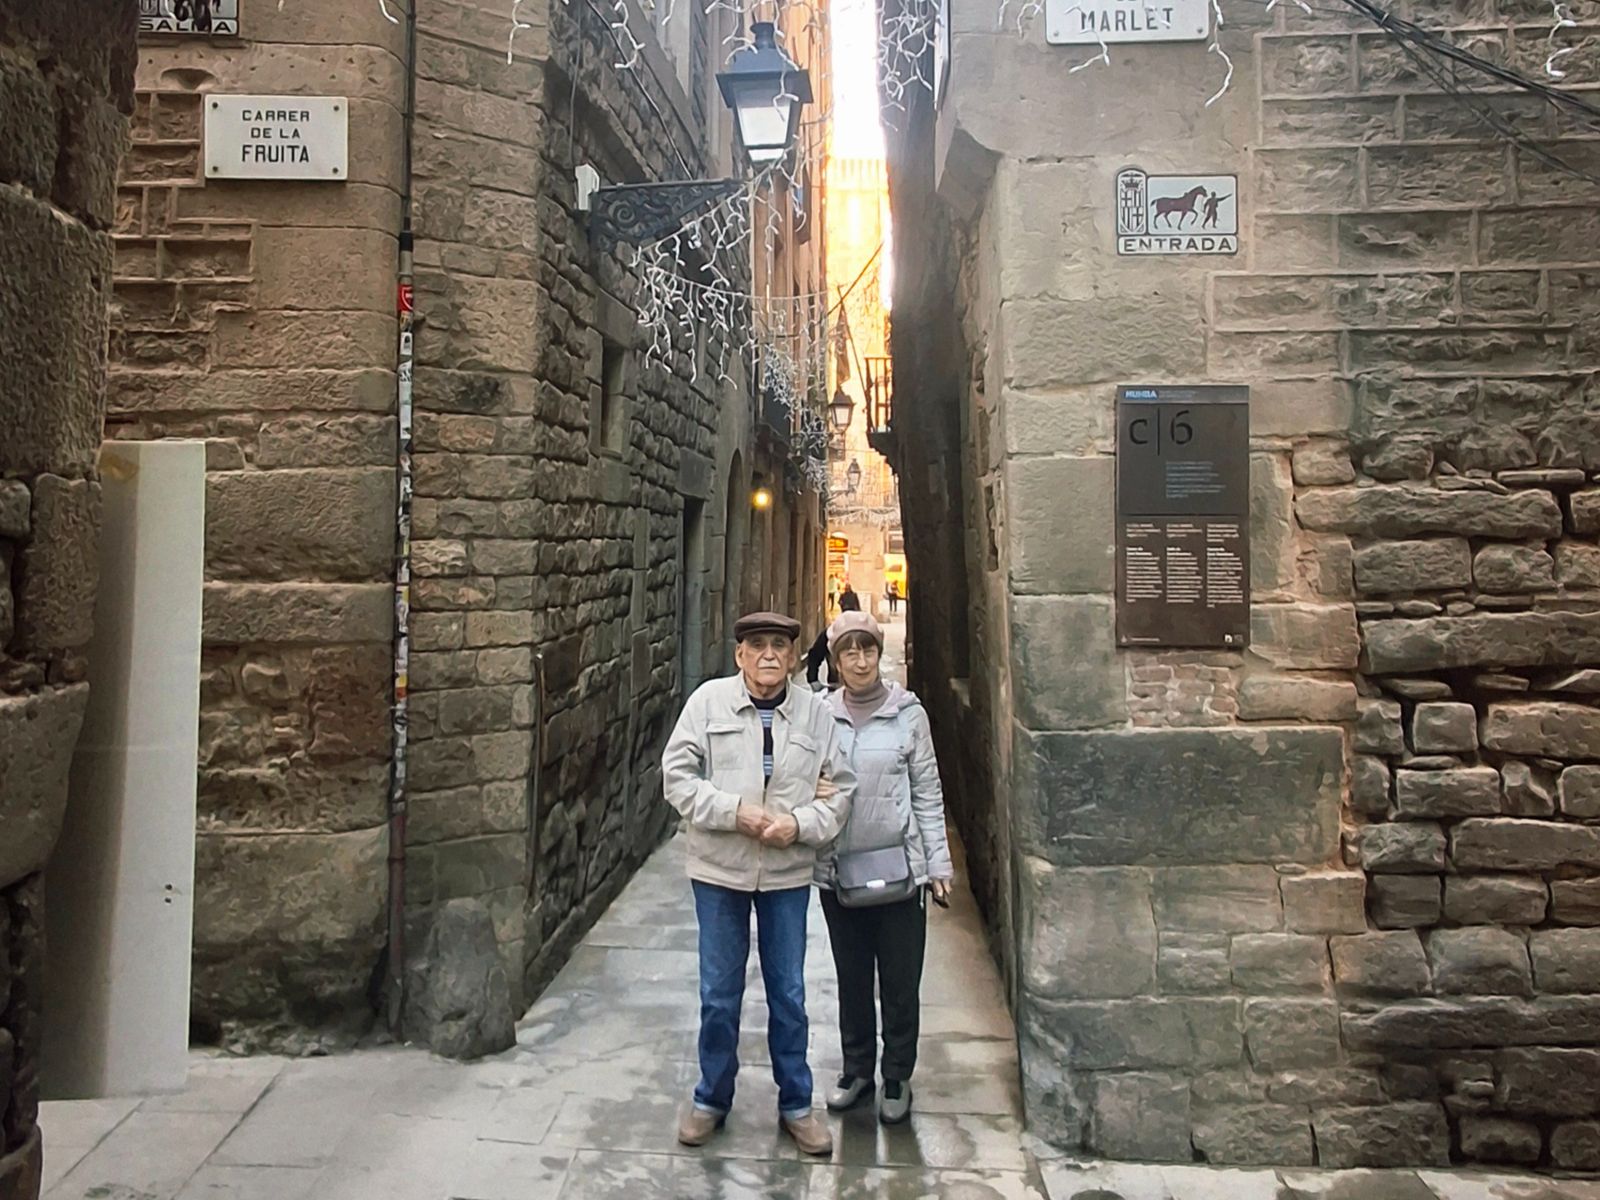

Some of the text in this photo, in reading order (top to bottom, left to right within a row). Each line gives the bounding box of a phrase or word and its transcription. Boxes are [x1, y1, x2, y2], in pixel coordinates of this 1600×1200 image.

[1080, 7, 1174, 32] MARLET
[241, 109, 310, 122] CARRER
[250, 127, 301, 139] DE LA
[241, 144, 310, 163] FRUITA
[1123, 237, 1233, 252] ENTRADA
